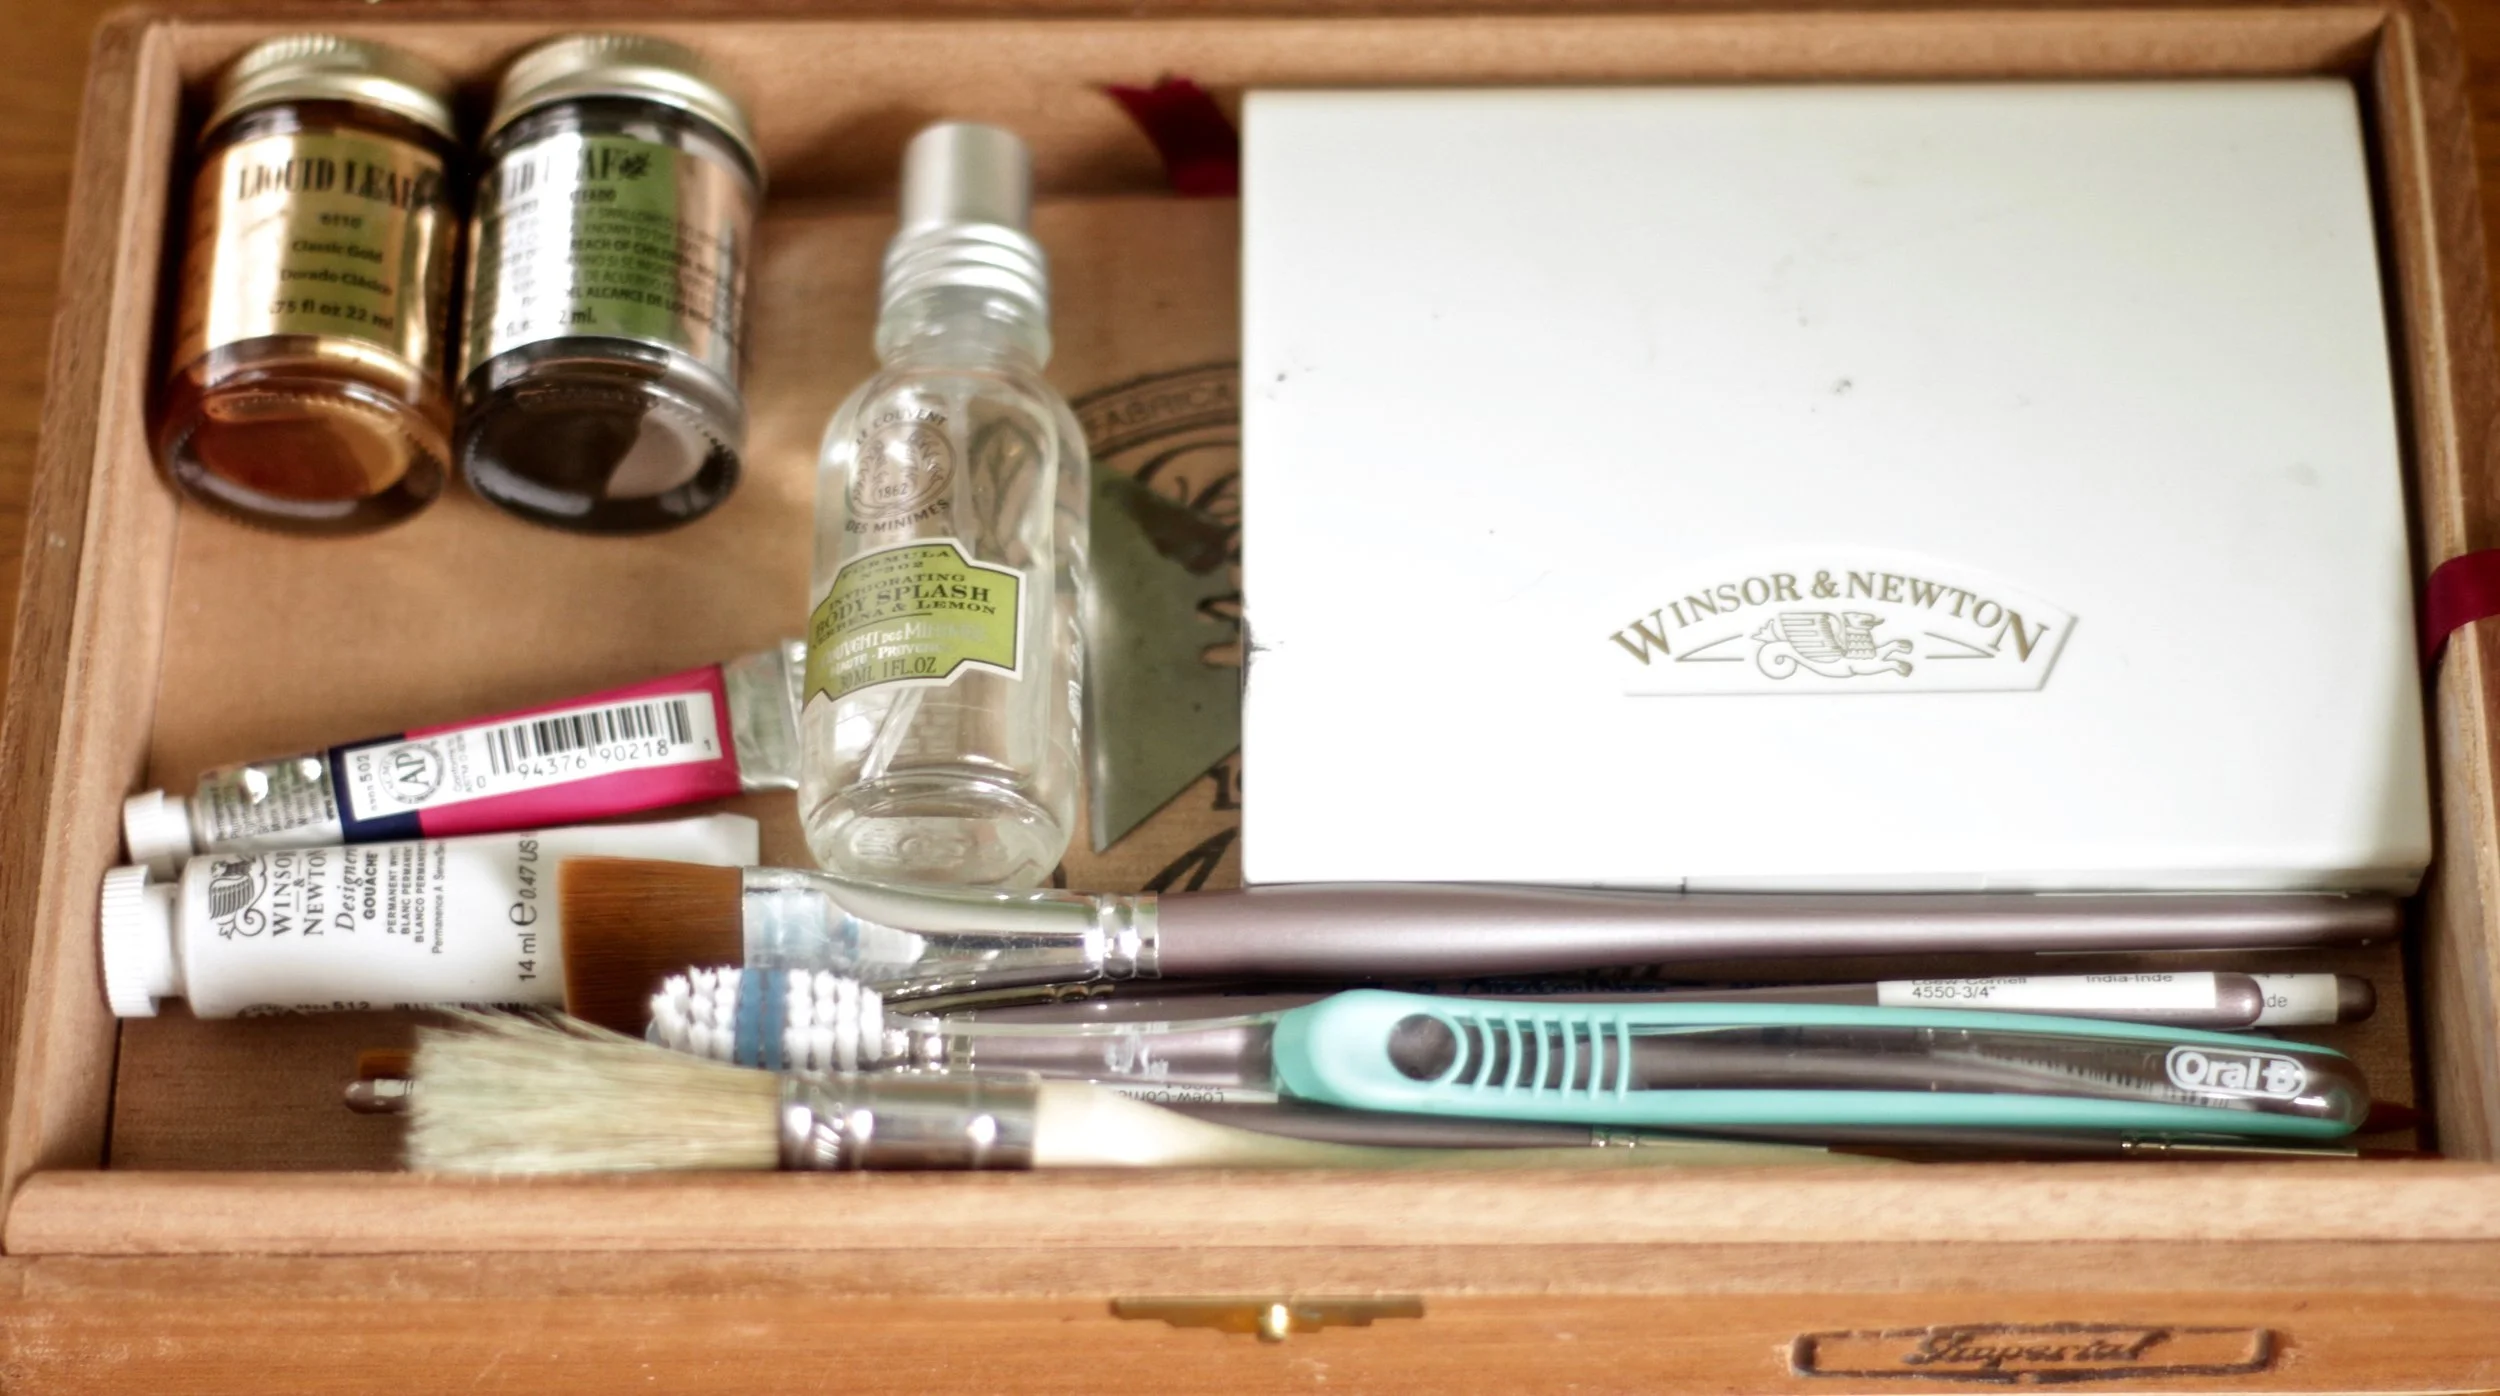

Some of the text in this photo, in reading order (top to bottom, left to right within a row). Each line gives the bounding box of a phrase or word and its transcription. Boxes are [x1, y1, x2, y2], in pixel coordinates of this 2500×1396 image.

[345, 305, 368, 322] 22
[845, 499, 950, 534] DES MINIMES
[829, 572, 966, 611] INVIGORATING
[915, 600, 997, 615] LEMON
[815, 583, 991, 638] BODY SPLASH
[1608, 569, 2051, 666] WINSOR & NEWTON
[356, 754, 373, 782] 502
[395, 753, 427, 786] AP
[476, 774, 486, 789] 0
[517, 755, 588, 780] 94376
[600, 738, 669, 763] 90218
[293, 878, 305, 888] &
[363, 852, 378, 920] GOUACHE
[519, 865, 537, 900] 0.47
[387, 870, 397, 934] PERMANENT
[400, 898, 411, 934] BLANC
[415, 897, 425, 943] BLANCO
[431, 894, 444, 954] Permanence
[518, 932, 537, 954] ml
[518, 959, 537, 981] 14
[2175, 1051, 2297, 1093] Oral-B
